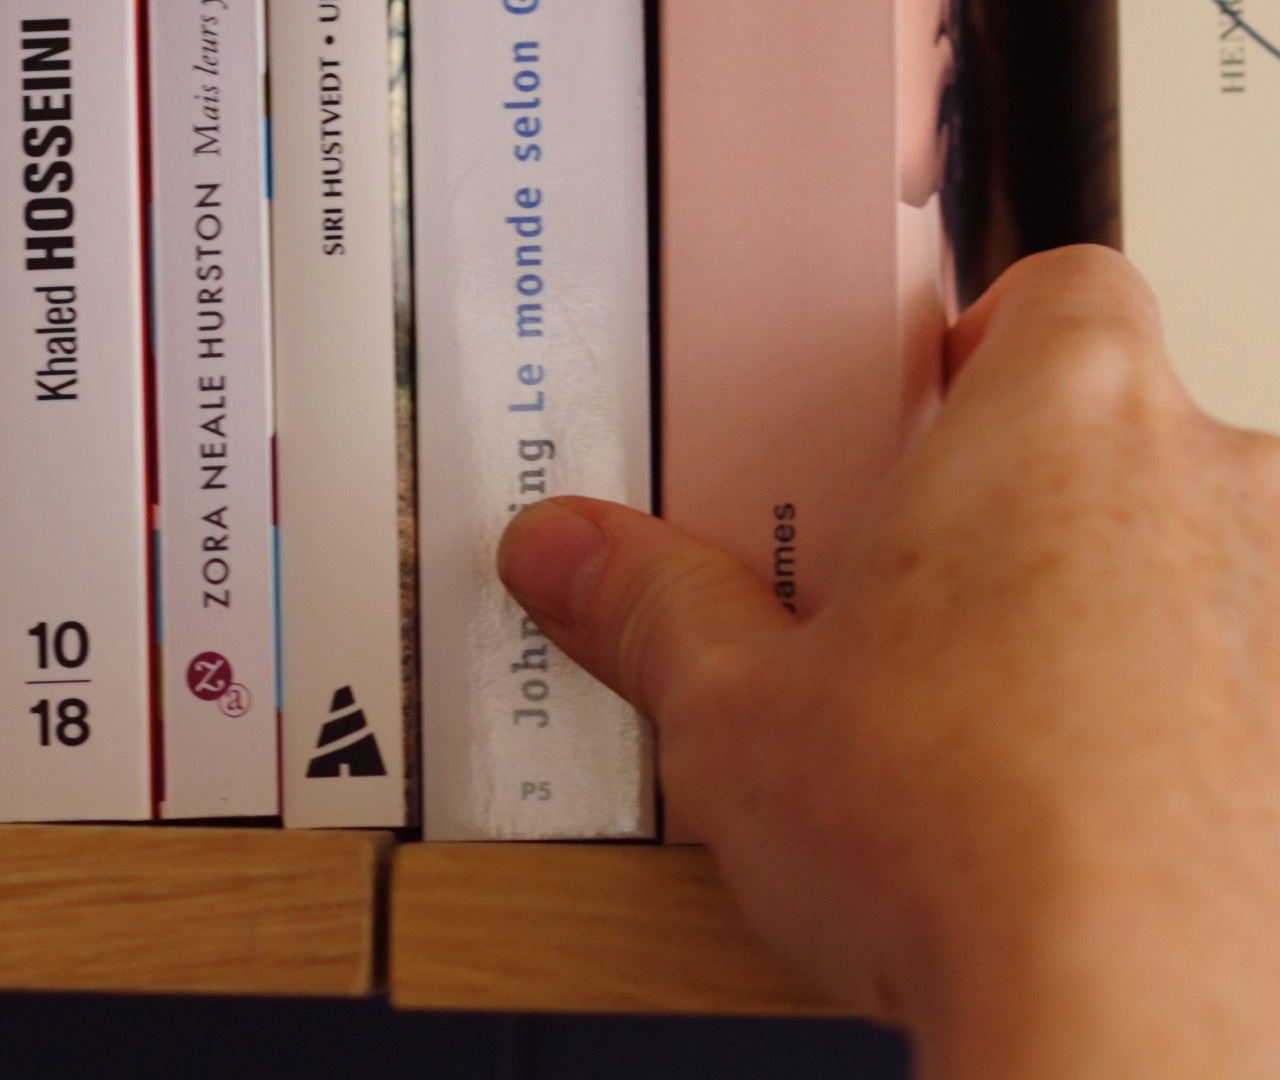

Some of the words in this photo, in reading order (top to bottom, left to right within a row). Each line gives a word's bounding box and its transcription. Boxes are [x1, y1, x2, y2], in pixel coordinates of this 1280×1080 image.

[191, 0, 218, 77] leurs
[20, 17, 77, 271] HOSSEINI
[192, 82, 220, 156] Mais
[320, 56, 344, 197] HUSTVEDT
[503, 40, 543, 163] selon
[195, 182, 226, 358] HURSTON
[323, 209, 346, 256] SIRI
[505, 188, 543, 339] monde
[35, 286, 78, 401] Khaled
[509, 363, 546, 413] Le
[199, 375, 228, 490] NEALE
[201, 504, 230, 610] ZORA
[28, 621, 89, 669] 10
[29, 697, 91, 747] 18
